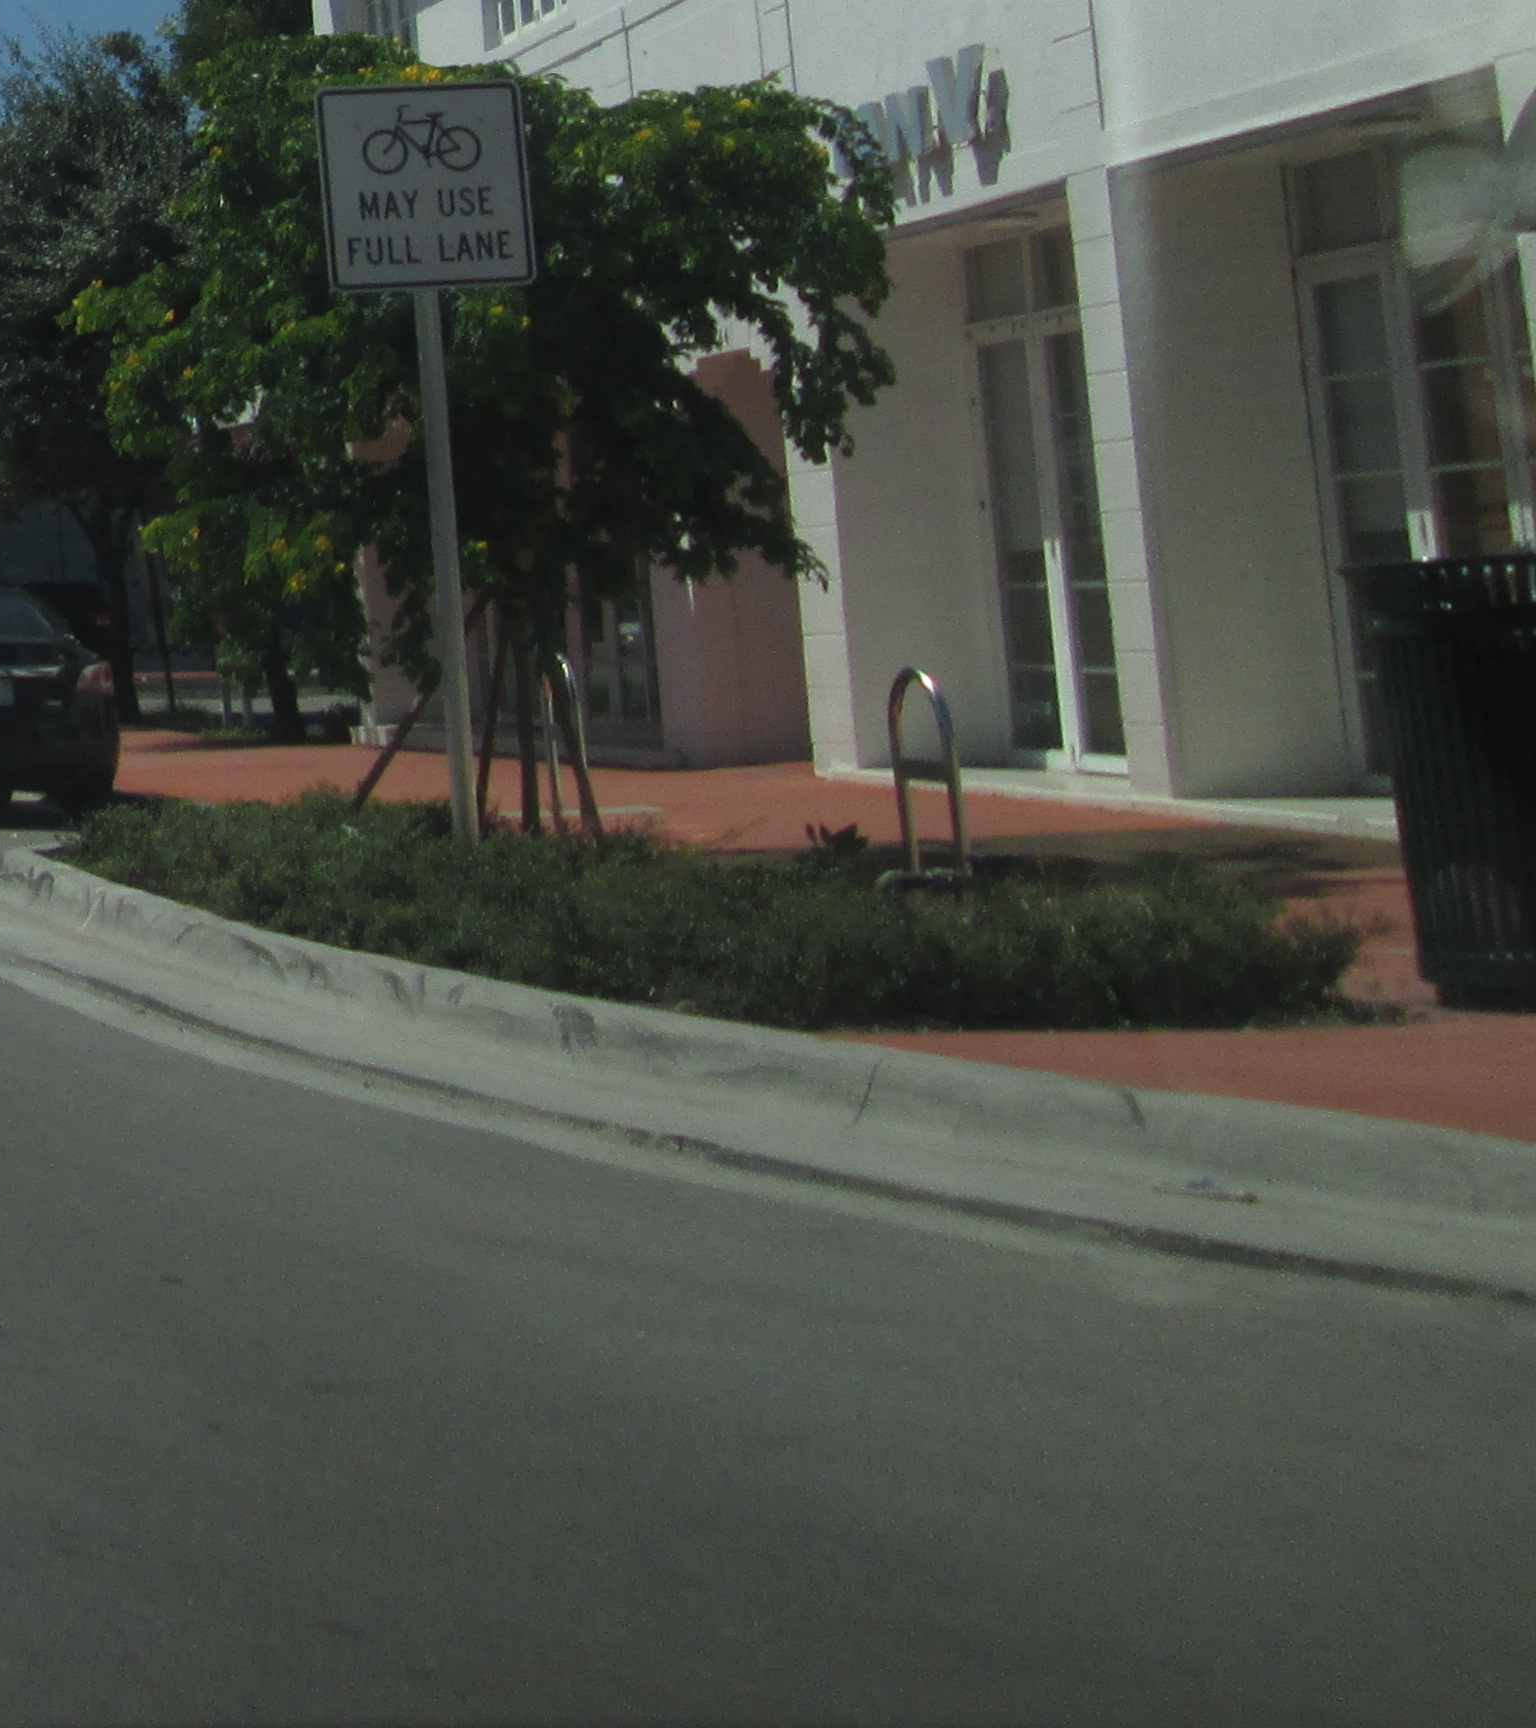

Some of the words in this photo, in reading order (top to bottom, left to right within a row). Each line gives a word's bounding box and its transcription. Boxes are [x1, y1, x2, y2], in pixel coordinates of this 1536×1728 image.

[358, 189, 419, 221] MAY
[437, 186, 494, 216] USE
[347, 236, 422, 266] FULL
[438, 230, 514, 261] LANE
